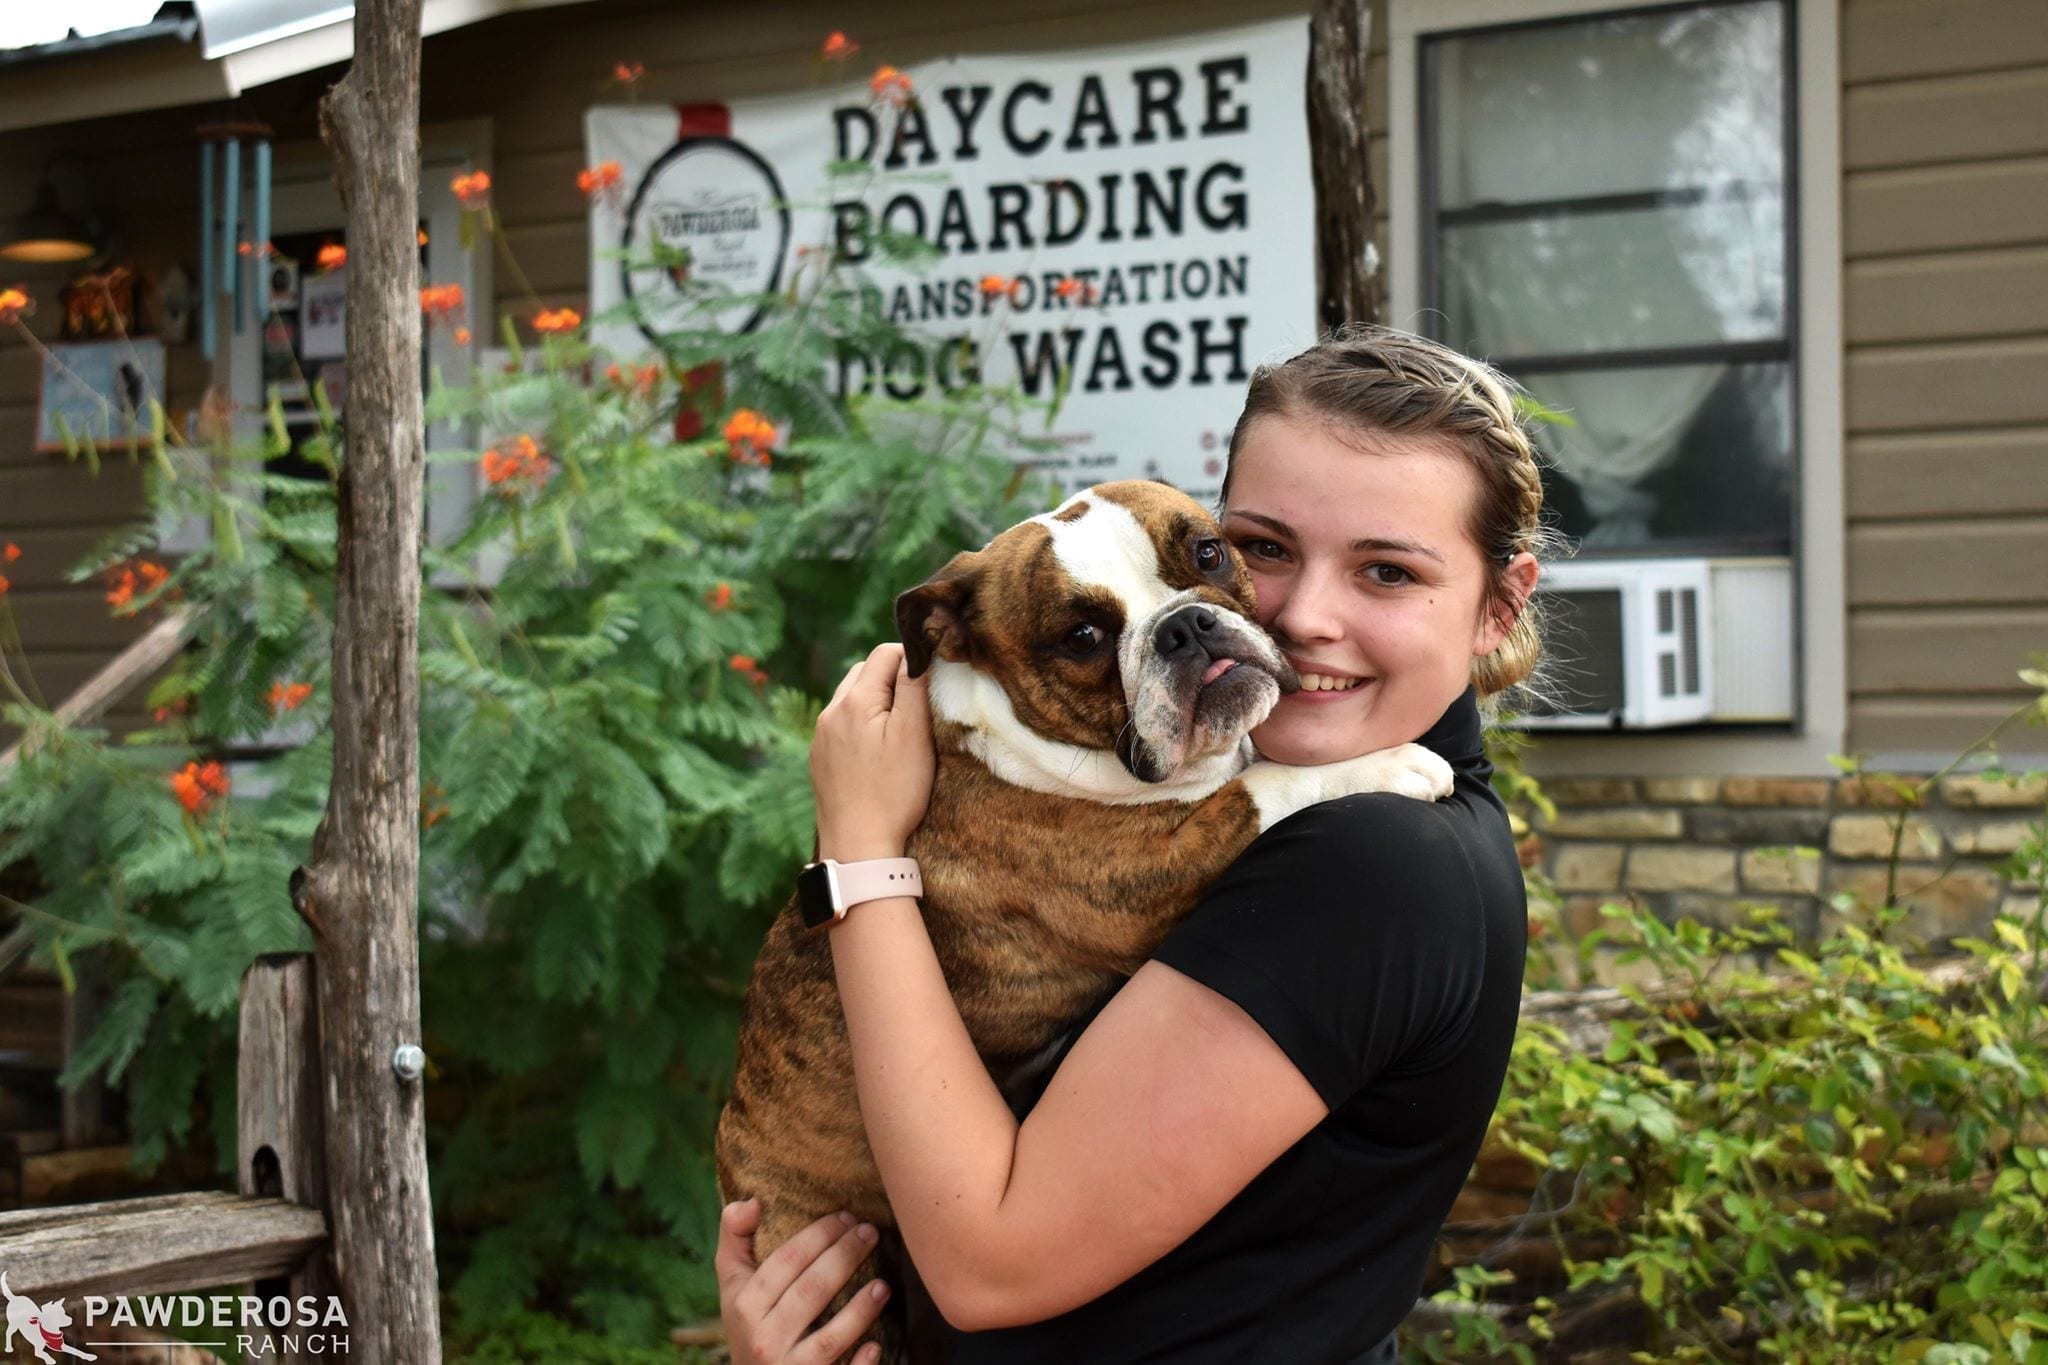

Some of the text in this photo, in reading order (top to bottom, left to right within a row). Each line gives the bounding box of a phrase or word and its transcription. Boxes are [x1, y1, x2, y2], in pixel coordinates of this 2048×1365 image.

[833, 56, 1249, 170] DAYCARE
[833, 162, 1249, 264] BOARDING
[834, 317, 1249, 400] DOG WASH
